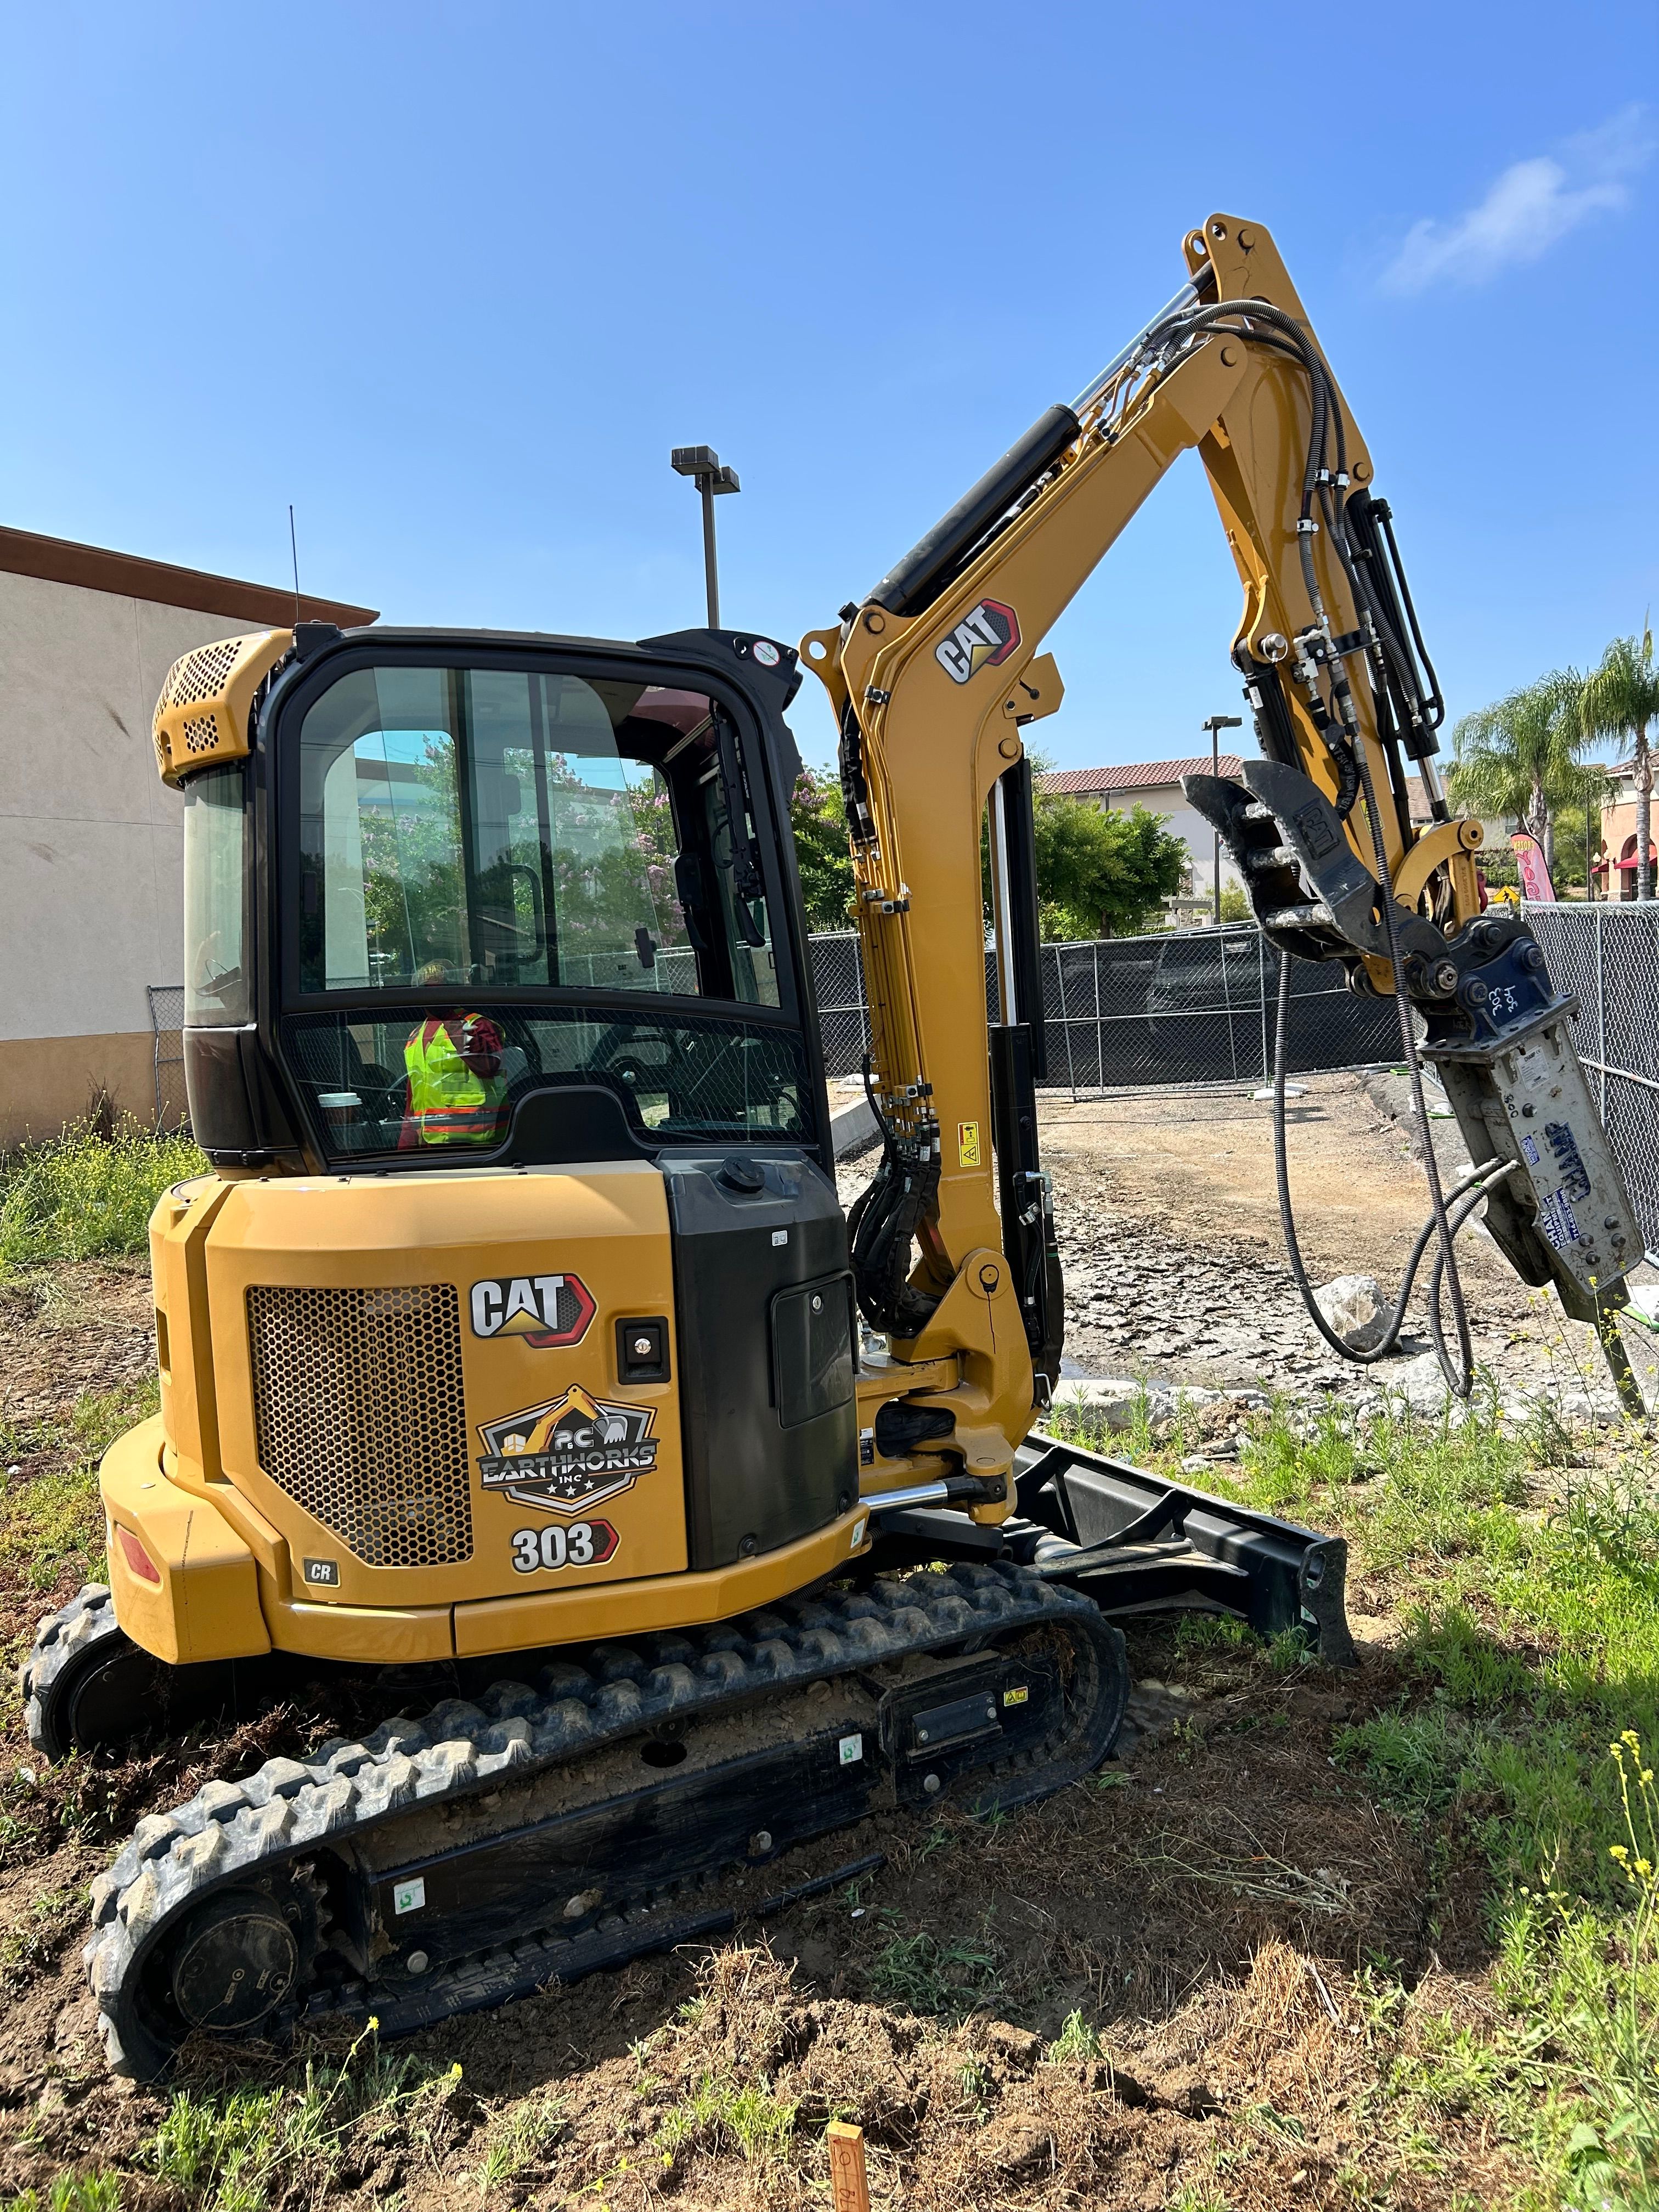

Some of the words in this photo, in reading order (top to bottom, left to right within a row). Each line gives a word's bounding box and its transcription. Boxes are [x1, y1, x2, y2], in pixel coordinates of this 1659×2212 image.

[936, 605, 1002, 682] CAT
[1302, 808, 1334, 849] CAT
[1488, 988, 1503, 1016] 303
[1504, 985, 1519, 1013] 304
[1542, 1211, 1560, 1250] CHAM
[472, 1276, 564, 1336] CAT
[482, 1446, 656, 1483] EARTHWORKS
[560, 1474, 582, 1484] INC
[512, 1522, 594, 1570] 303
[311, 1564, 331, 1581] CR
